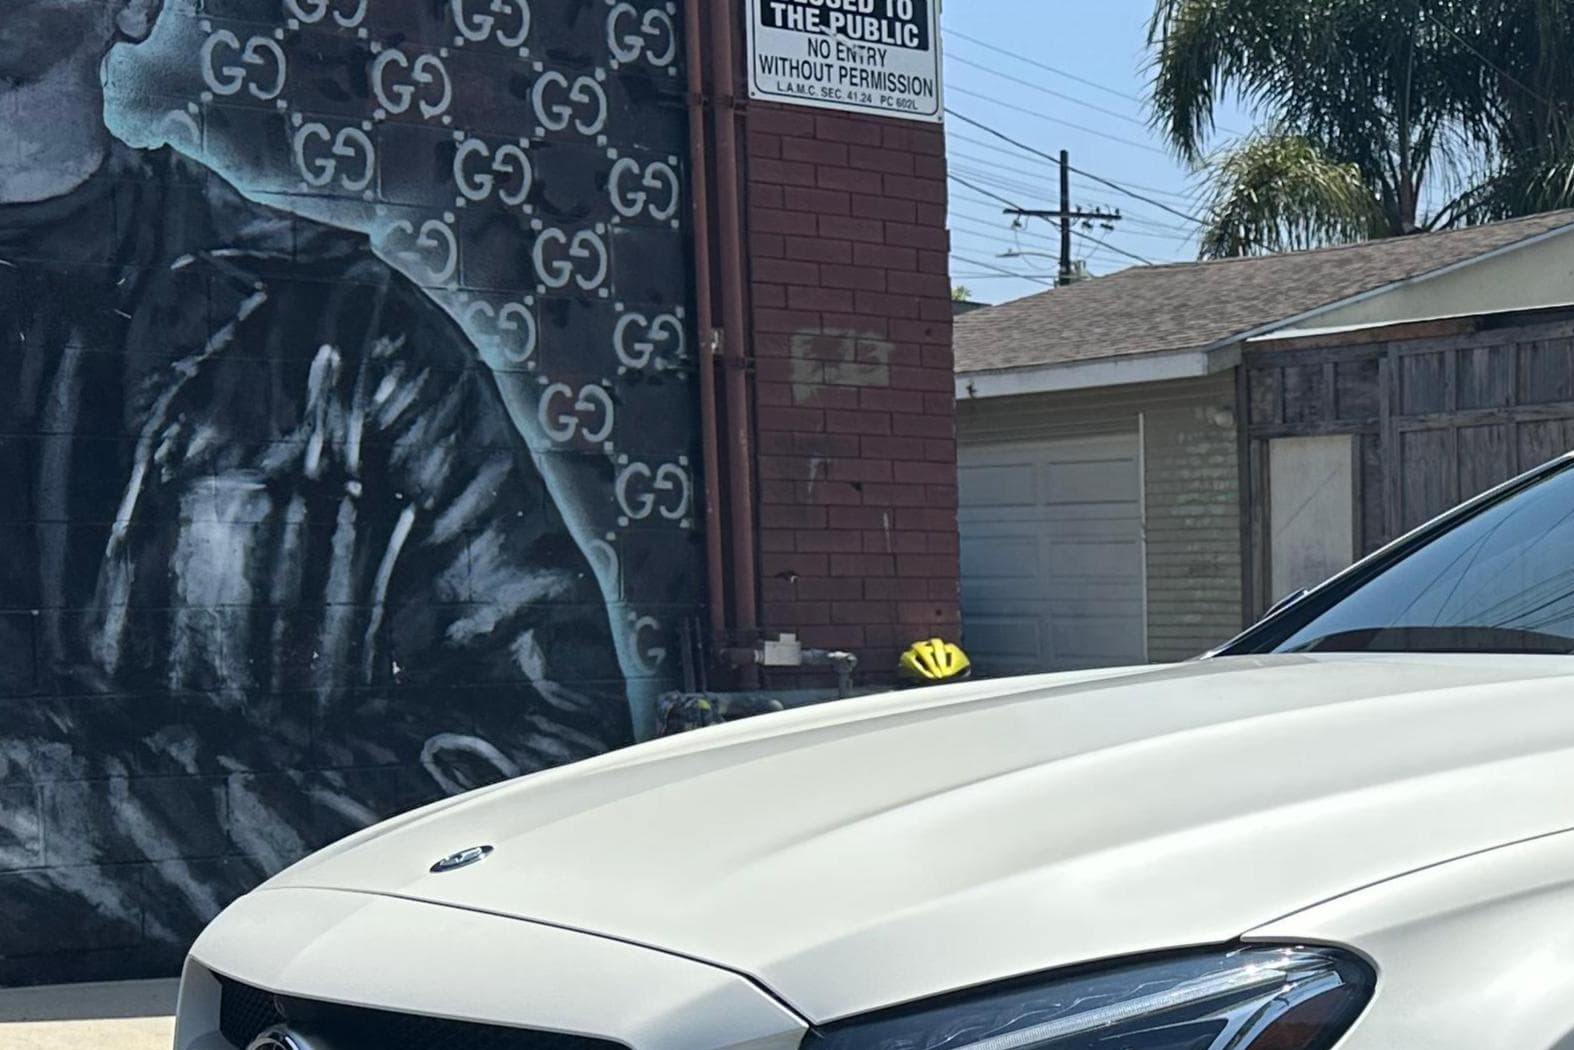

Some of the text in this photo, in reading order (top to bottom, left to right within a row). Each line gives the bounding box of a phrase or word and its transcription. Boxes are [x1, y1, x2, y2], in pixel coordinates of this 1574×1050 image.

[770, 2, 821, 32] THE
[829, 11, 920, 48] PUBLIC
[808, 37, 887, 67] NO ENTRY
[759, 54, 933, 98] WITHOUT PERMISSION
[881, 95, 893, 106] PC
